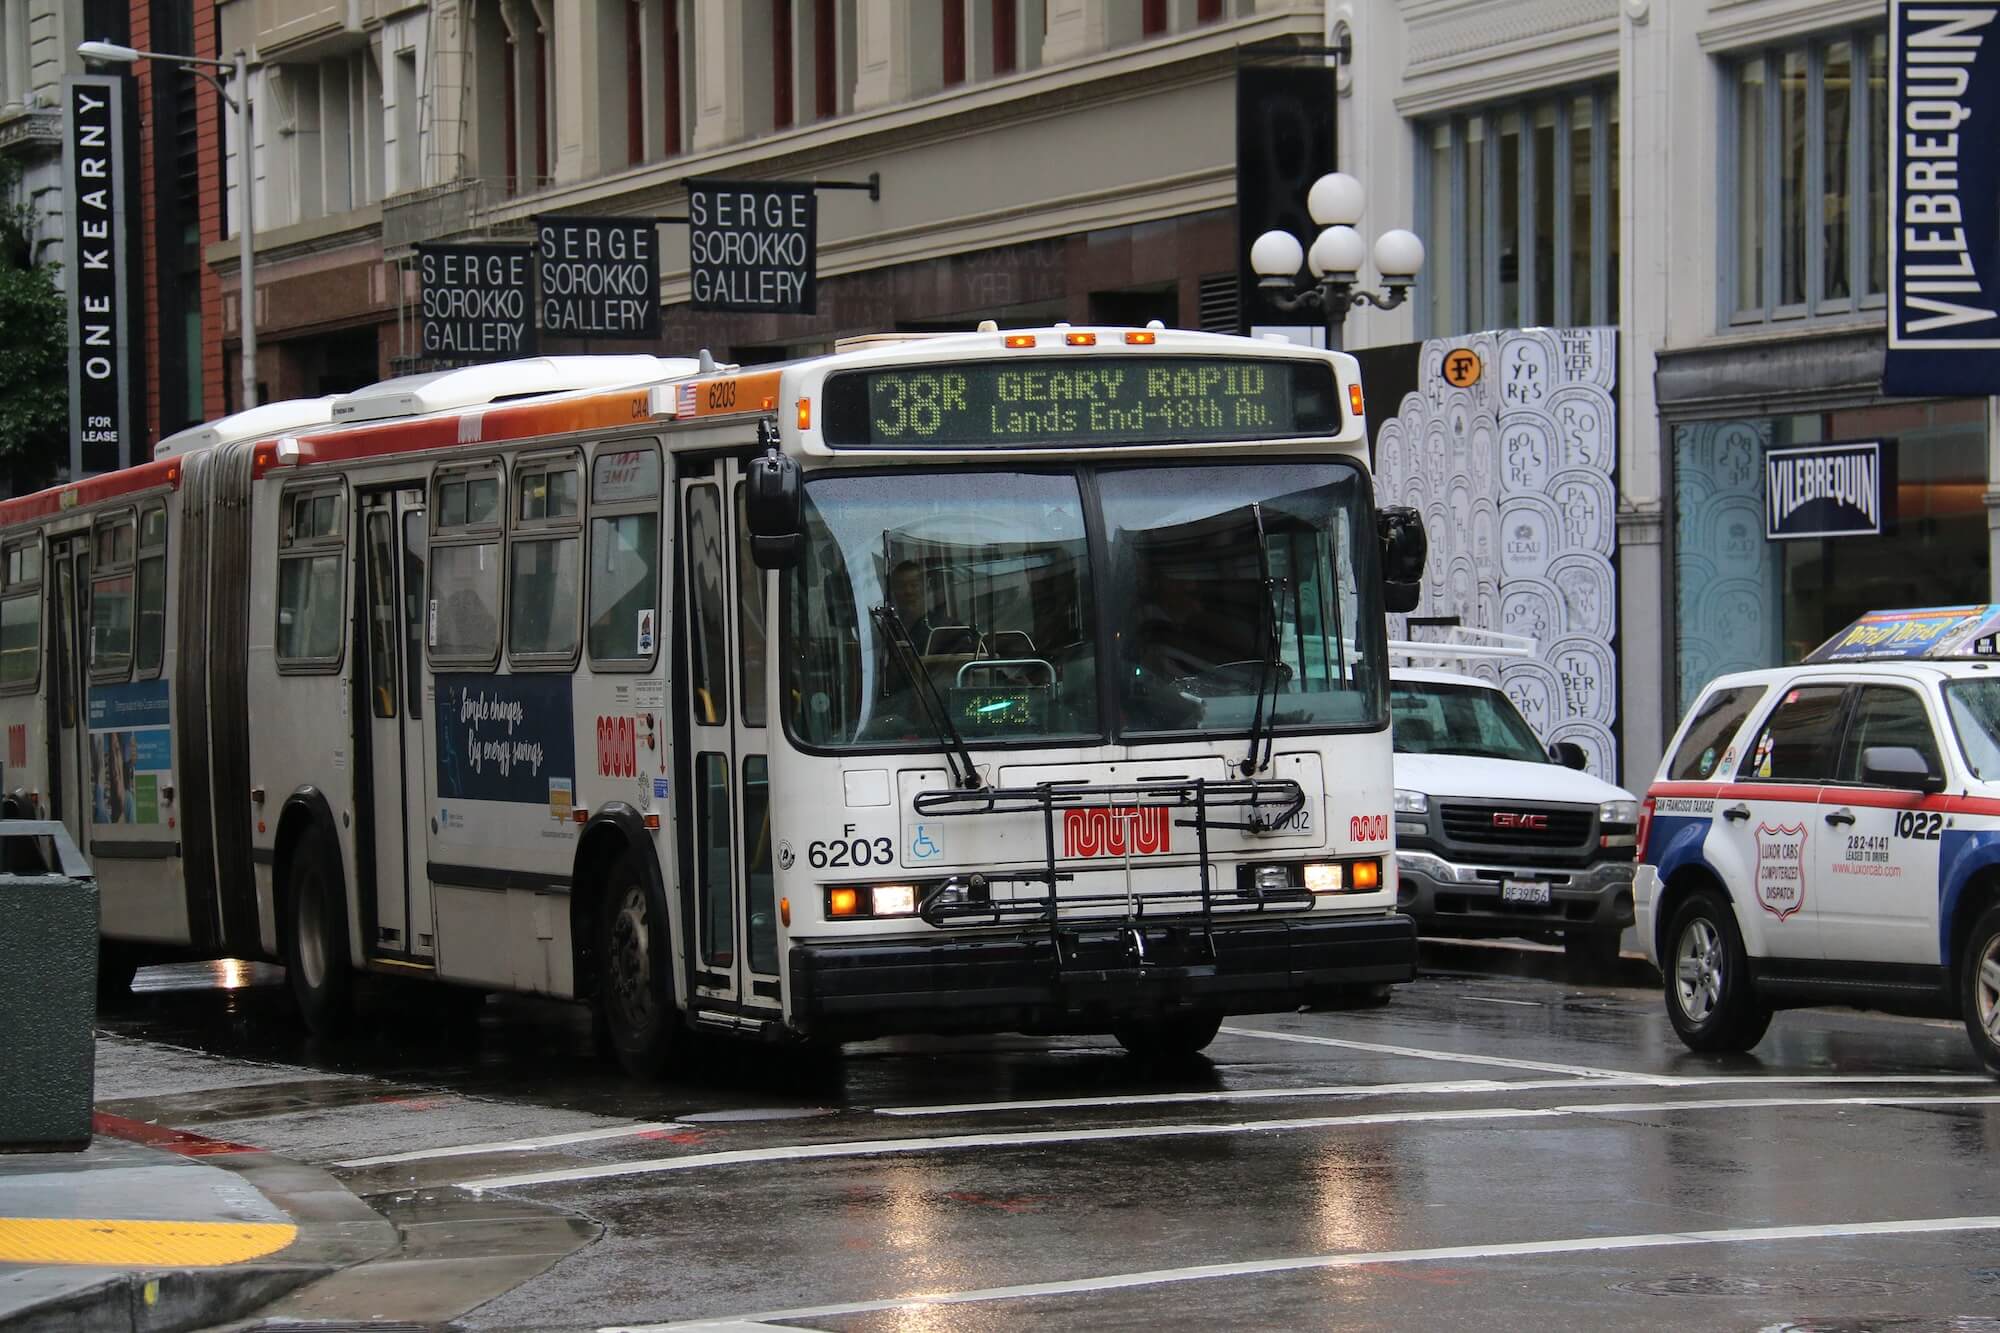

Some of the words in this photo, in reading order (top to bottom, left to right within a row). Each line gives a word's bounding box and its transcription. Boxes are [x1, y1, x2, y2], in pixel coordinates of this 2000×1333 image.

[79, 93, 109, 269] KEARNY
[1905, 8, 1998, 334] VILEBREQUIN
[691, 192, 807, 228] SERGE
[541, 227, 648, 259] SERGE
[692, 231, 807, 266] SOROKKO
[422, 255, 524, 285] SERGE
[543, 264, 648, 295] SOROKKO
[694, 269, 808, 304] GALLERY
[423, 288, 524, 319] SOROKKO
[544, 300, 649, 331] GALLERY
[85, 295, 111, 380] ONE
[424, 323, 524, 352] GALLERY
[709, 380, 736, 409] 6203
[875, 373, 966, 436] 38R
[998, 367, 1125, 401] GEARY
[1146, 364, 1265, 399] RAPID
[88, 415, 111, 428] FOR
[991, 403, 1078, 434] Lands
[1090, 399, 1223, 432] End-48th
[1235, 399, 1274, 427] Av.
[82, 430, 118, 443] LEASE
[1769, 452, 1876, 531] VILEBREQUIN
[461, 686, 490, 731] Simple
[489, 691, 523, 736] changes.
[468, 728, 482, 775] Big
[483, 740, 510, 777] energy
[512, 739, 544, 777] savings.
[1656, 799, 1665, 811] SAN
[1665, 799, 1692, 812] FRANCISCO
[843, 823, 856, 838] F
[1492, 812, 1549, 831] GMC
[1894, 811, 1943, 841] 1022
[808, 837, 894, 869] 6203
[1761, 844, 1781, 859] LUXOR
[1782, 843, 1798, 860] CABS
[1845, 850, 1863, 862] LEASED
[1864, 851, 1871, 861] TO
[1872, 852, 1889, 862] DRIVER
[1847, 835, 1889, 851] 282-4141
[1761, 866, 1799, 881] COMPUTERIZED
[1831, 863, 1903, 878] www.luxorcab.com
[1765, 886, 1796, 900] DISPATCH
